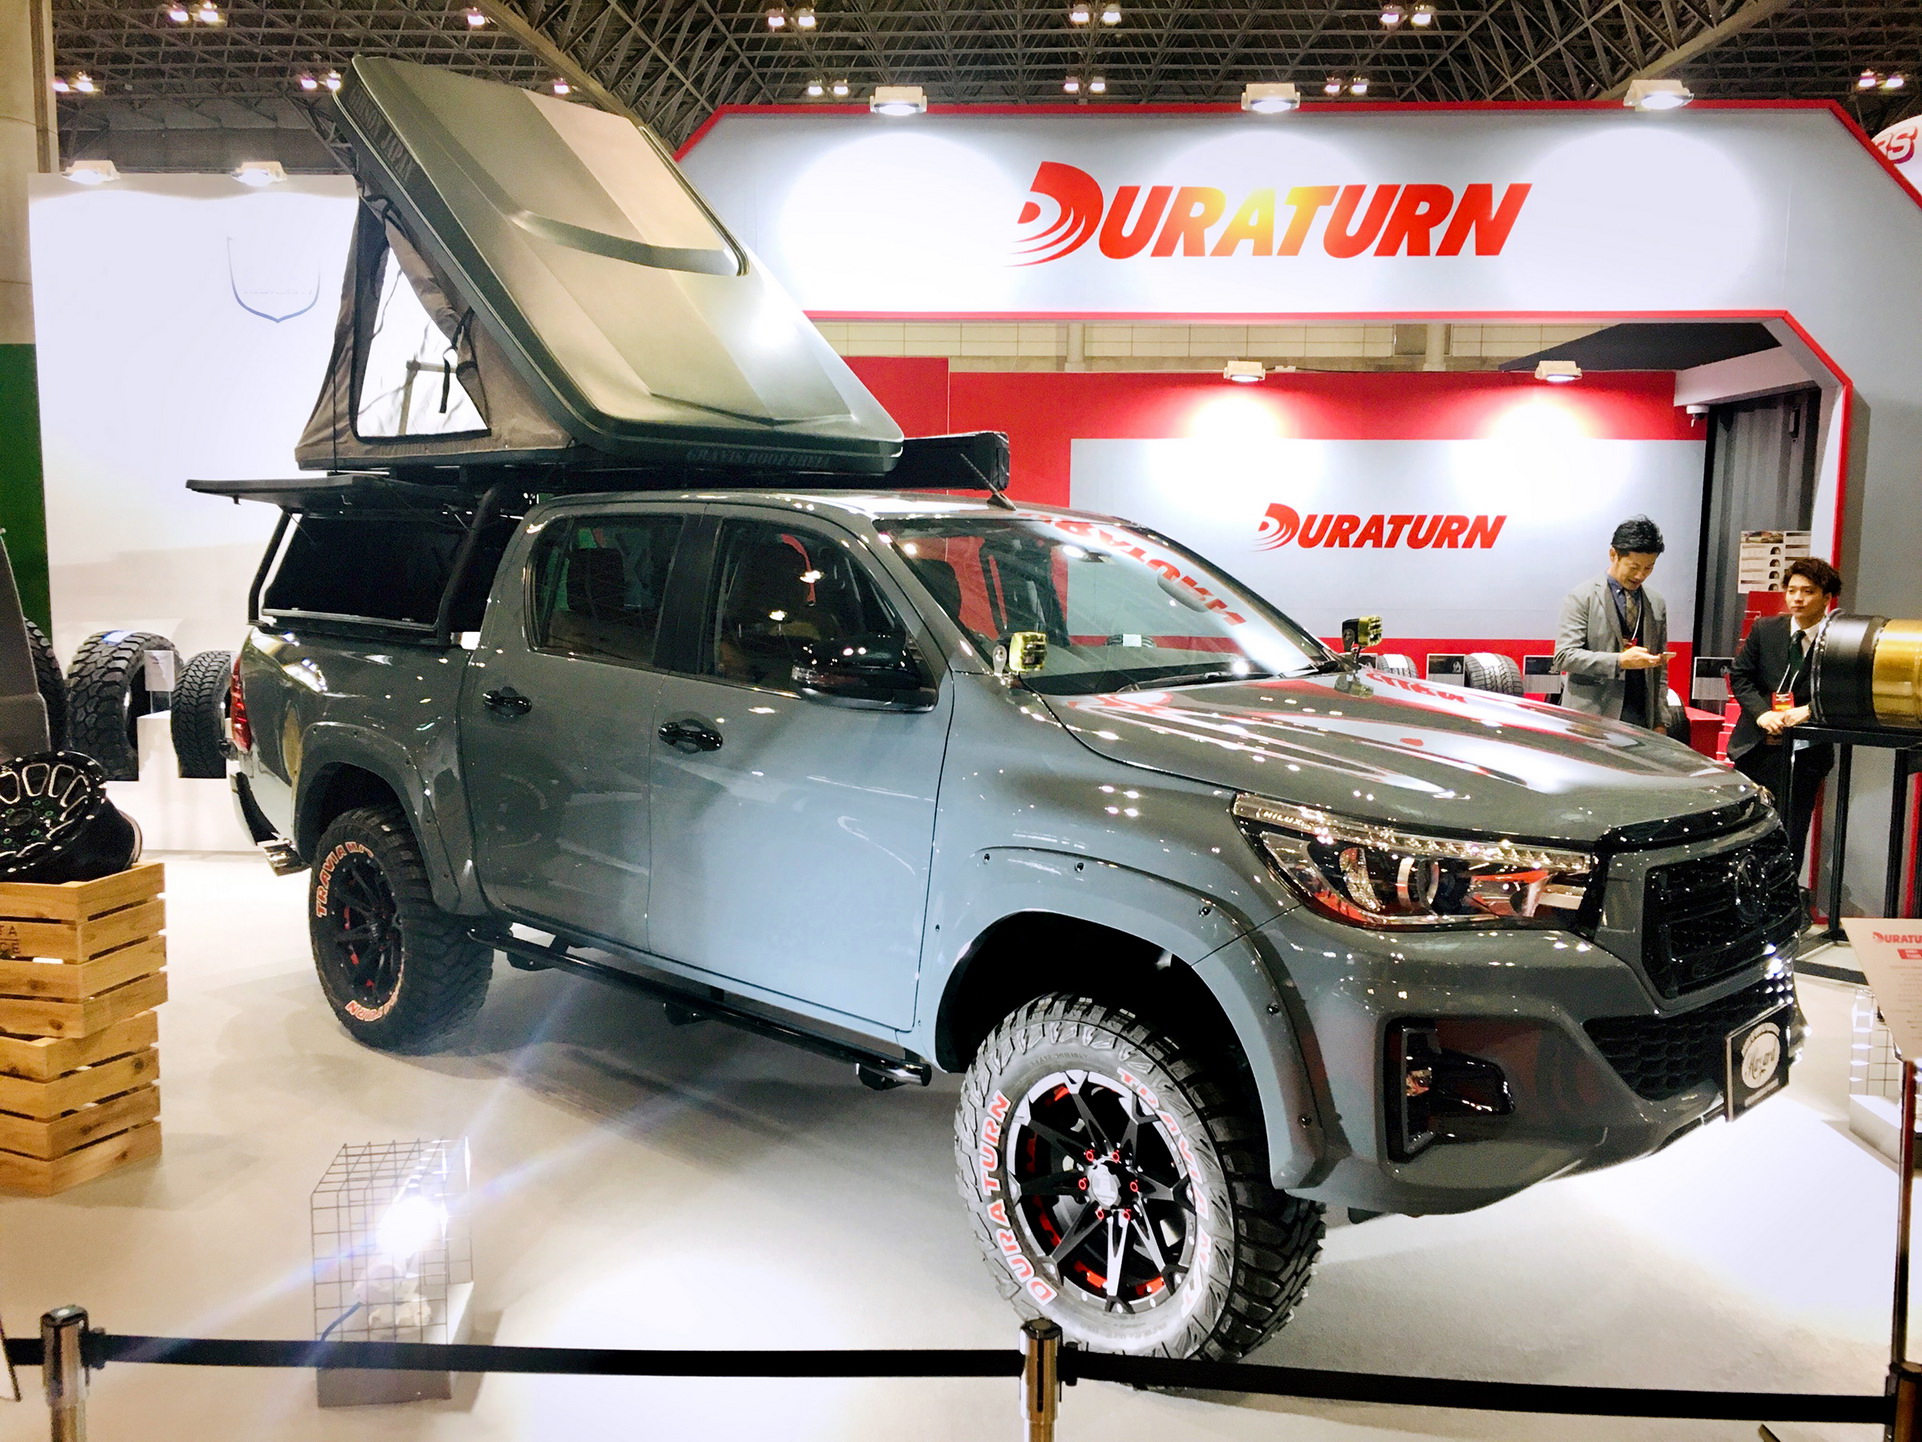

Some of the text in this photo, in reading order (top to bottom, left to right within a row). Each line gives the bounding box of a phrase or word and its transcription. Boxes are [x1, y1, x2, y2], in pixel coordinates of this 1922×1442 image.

[1004, 160, 1533, 267] DURATURN
[1251, 502, 1508, 551] DURATURN
[1263, 811, 1303, 826] HILUX
[316, 843, 347, 918] TRAVIA
[978, 1089, 1058, 1306] DURATURN
